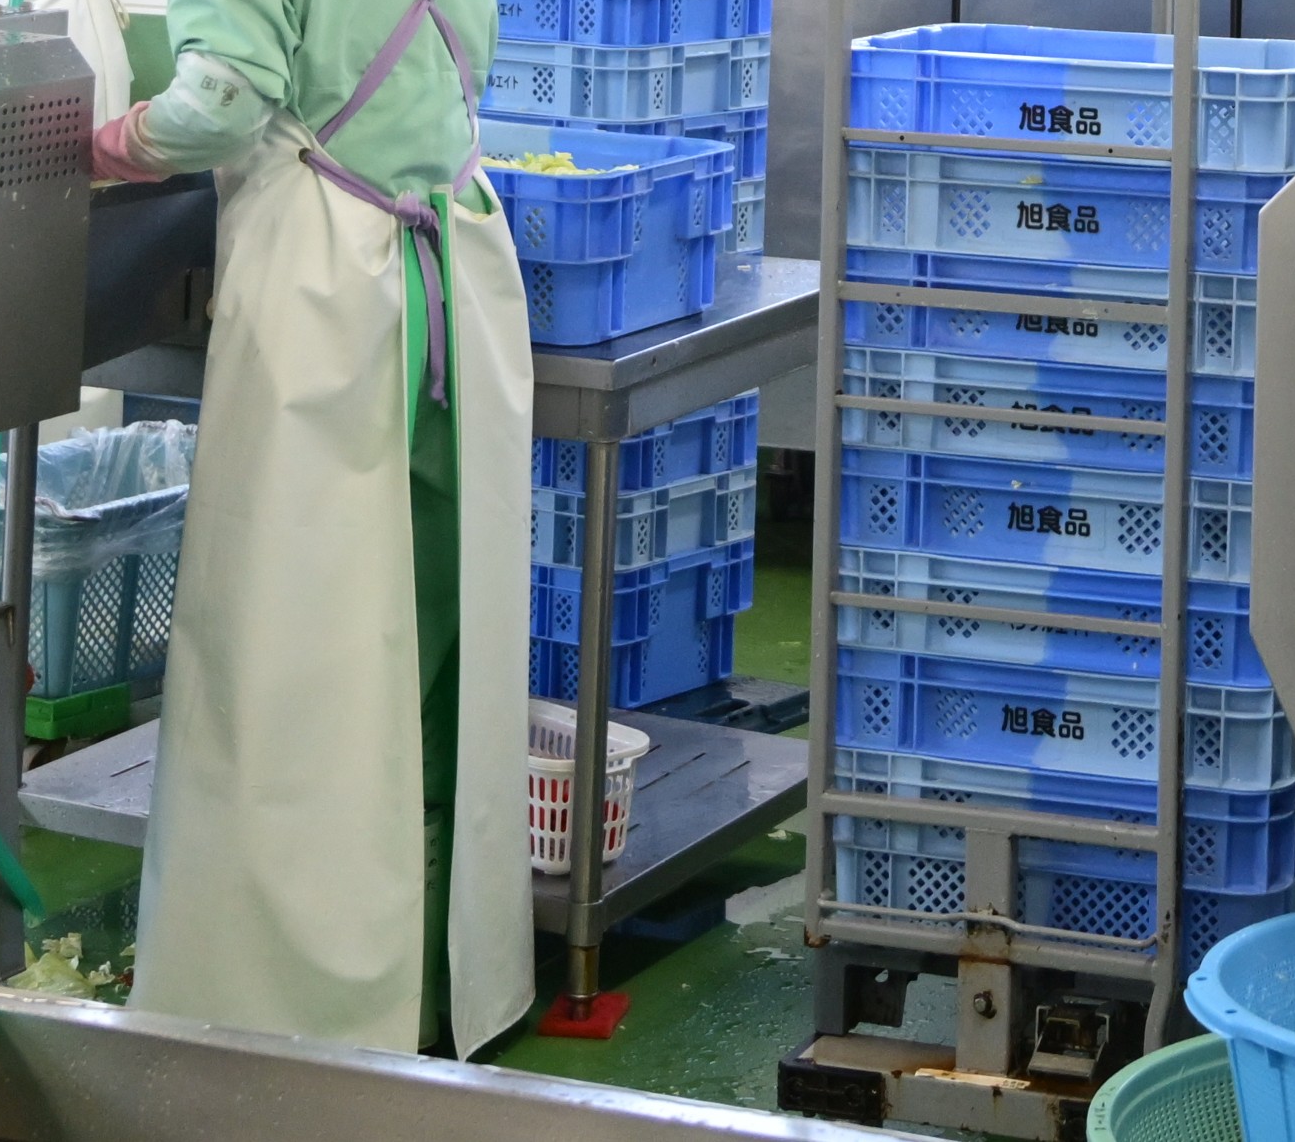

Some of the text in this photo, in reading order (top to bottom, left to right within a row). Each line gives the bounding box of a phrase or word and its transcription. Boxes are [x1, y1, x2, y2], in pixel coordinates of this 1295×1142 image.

[497, 2, 523, 17] エイト
[1018, 102, 1102, 136] 旭食品
[1016, 200, 1100, 234] 旭食品
[1007, 501, 1091, 537] 旭食品
[1001, 703, 1084, 740] 旭食品
